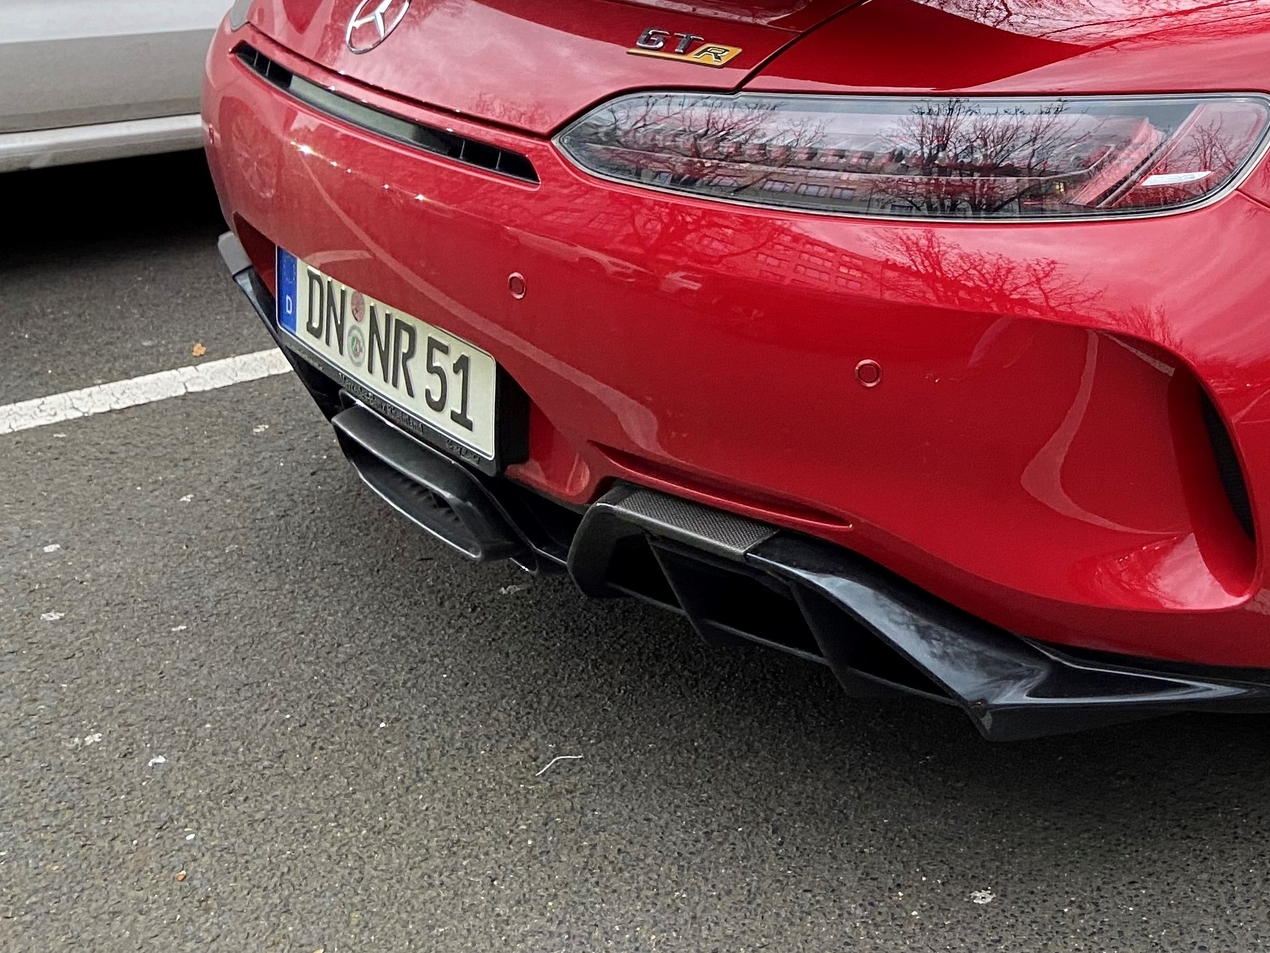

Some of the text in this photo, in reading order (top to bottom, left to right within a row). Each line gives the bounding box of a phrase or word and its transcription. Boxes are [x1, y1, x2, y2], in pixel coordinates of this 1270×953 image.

[285, 294, 293, 315] D
[306, 266, 474, 432] DN NR 51
